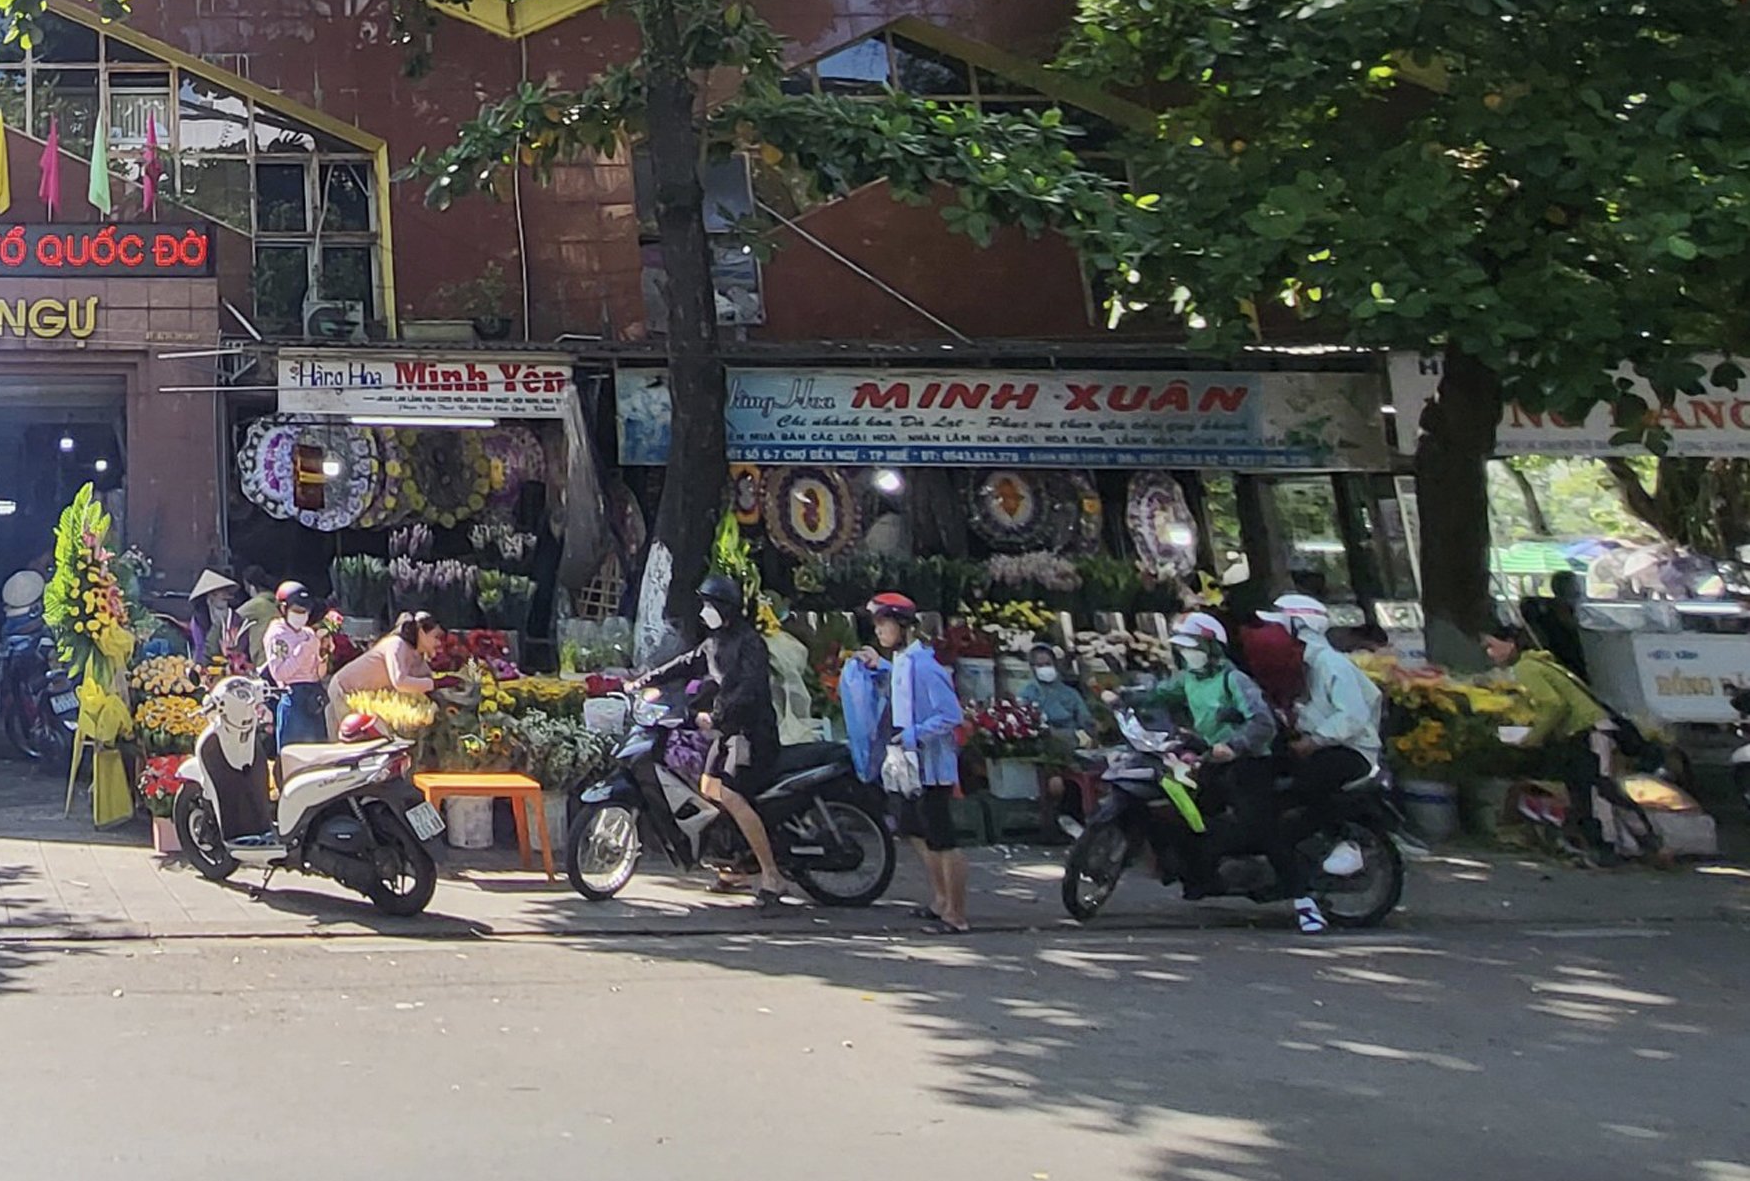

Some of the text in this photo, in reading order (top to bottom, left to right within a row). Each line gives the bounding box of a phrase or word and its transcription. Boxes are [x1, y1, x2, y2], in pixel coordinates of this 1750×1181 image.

[36, 225, 145, 267] QUỐC
[298, 360, 568, 394] Hàng Hoa Minh Yên
[850, 380, 1040, 411] MINH
[1062, 379, 1249, 413] XUÂN
[749, 431, 776, 442] MUA
[810, 432, 834, 442] CÁC
